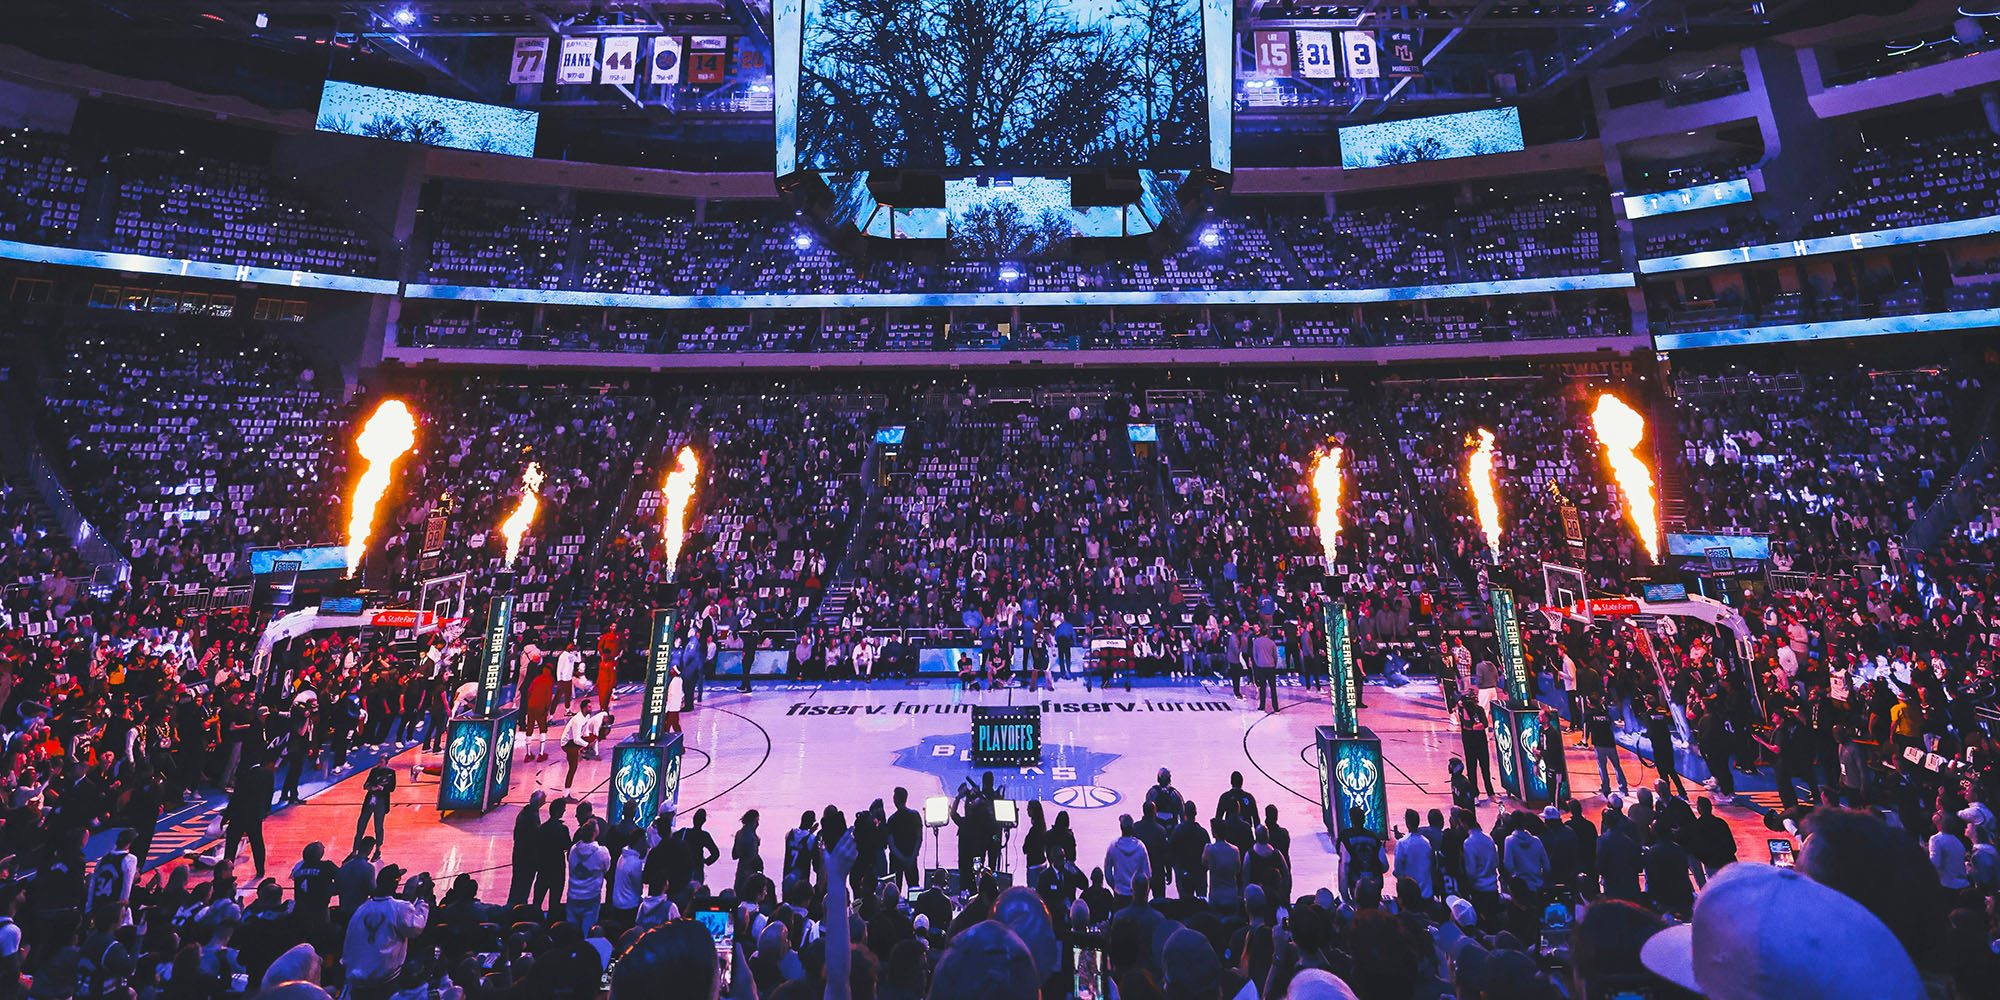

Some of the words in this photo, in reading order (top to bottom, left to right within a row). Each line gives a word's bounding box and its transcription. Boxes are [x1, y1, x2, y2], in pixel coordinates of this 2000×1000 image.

[516, 50, 543, 72] 77
[563, 53, 592, 67] HANK
[605, 51, 632, 70] 44
[697, 55, 717, 70] 14
[741, 51, 764, 69] 20
[1260, 43, 1288, 66] 15
[1306, 43, 1330, 65] 31
[1354, 43, 1371, 65] 3
[1394, 44, 1414, 62] MU
[1650, 186, 1722, 210] THE
[1740, 233, 1864, 263] THE
[180, 259, 303, 287] THE
[1538, 361, 1633, 376] TWATER
[1601, 602, 1618, 611] State
[1618, 602, 1633, 610] Farm
[387, 615, 404, 623] State
[490, 627, 505, 652] FEAR
[1505, 619, 1520, 645] FEAR
[655, 644, 669, 672] FEAR
[1341, 637, 1352, 665] FEAR
[485, 665, 499, 689] DEER
[656, 672, 664, 686] THE
[1512, 657, 1526, 683] DEER
[650, 686, 665, 714] DEER
[1345, 679, 1356, 707] DEER
[979, 724, 1034, 751] PLAYOFFS
[95, 877, 113, 897] 34
